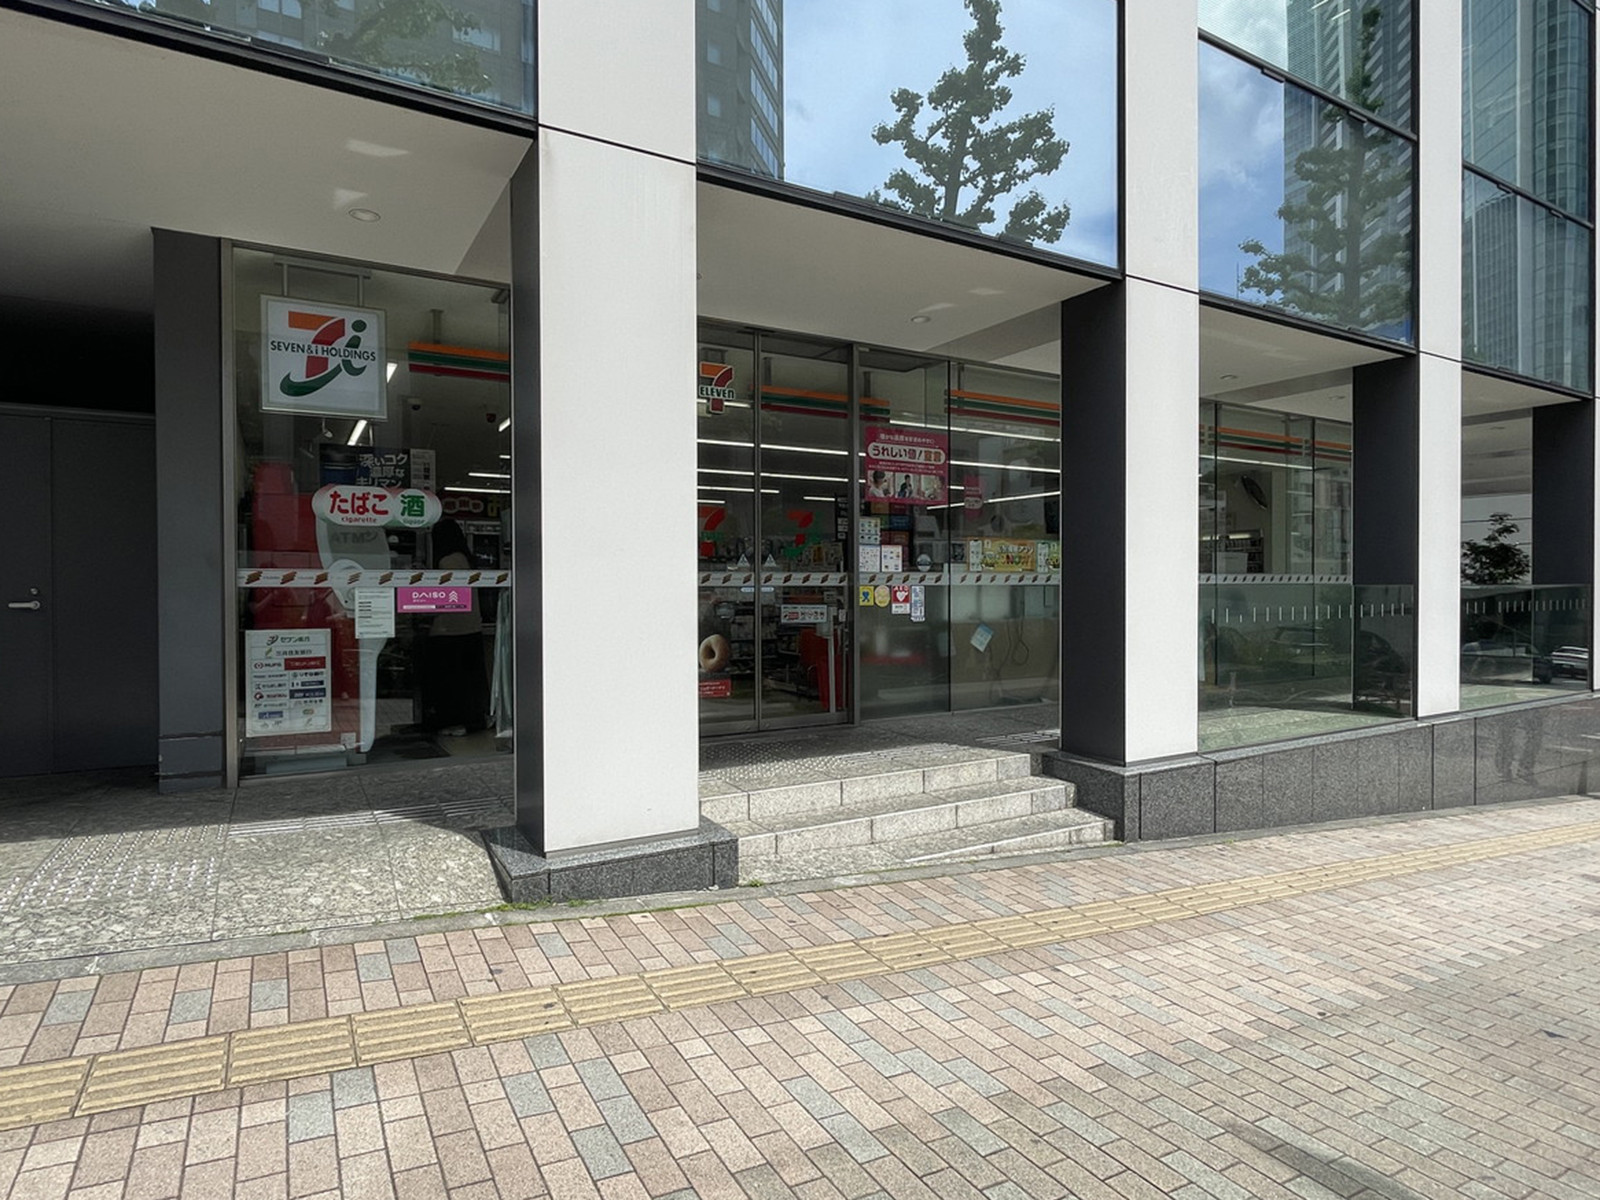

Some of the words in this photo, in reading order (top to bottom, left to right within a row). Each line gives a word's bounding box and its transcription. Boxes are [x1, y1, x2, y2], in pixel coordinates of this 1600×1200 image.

[321, 345, 376, 361] HOLDINGS
[329, 491, 389, 515] たばこ
[401, 494, 425, 517] 酒
[412, 591, 446, 599] DAISO
